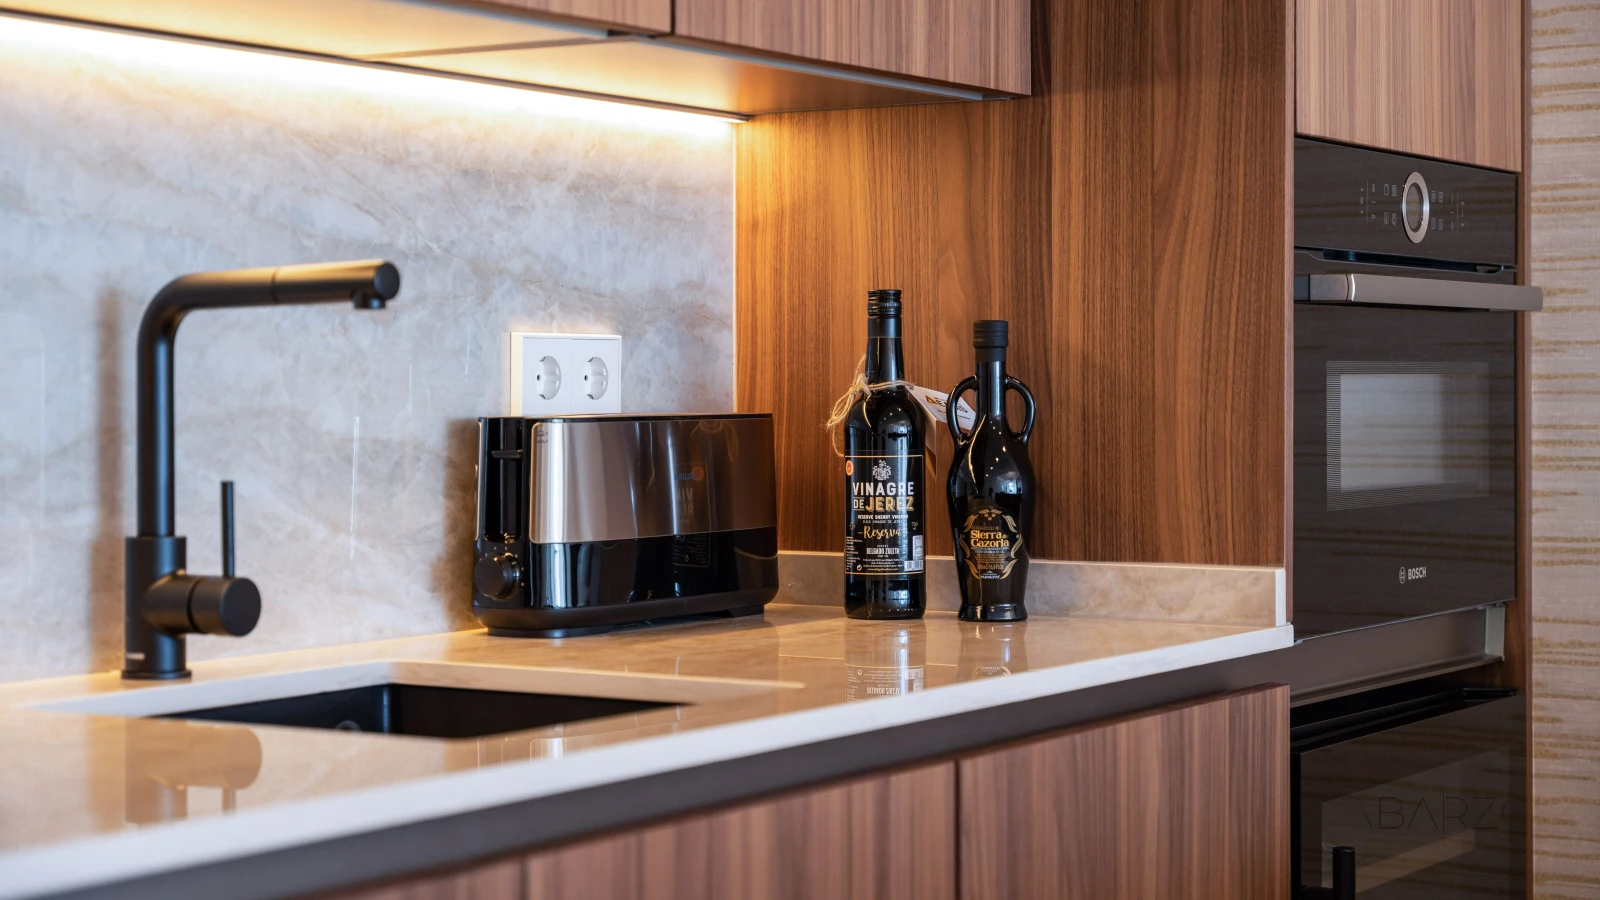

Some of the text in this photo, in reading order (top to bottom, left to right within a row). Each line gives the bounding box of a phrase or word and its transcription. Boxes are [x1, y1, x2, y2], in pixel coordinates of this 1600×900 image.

[852, 482, 914, 496] VINAGRE
[853, 496, 914, 512] DE JEREZ
[863, 525, 901, 539] Reserva
[970, 529, 1002, 540] Sierra
[970, 538, 1010, 548] Cazorla
[866, 547, 884, 555] DELGADO
[1407, 566, 1427, 580] BOSCH
